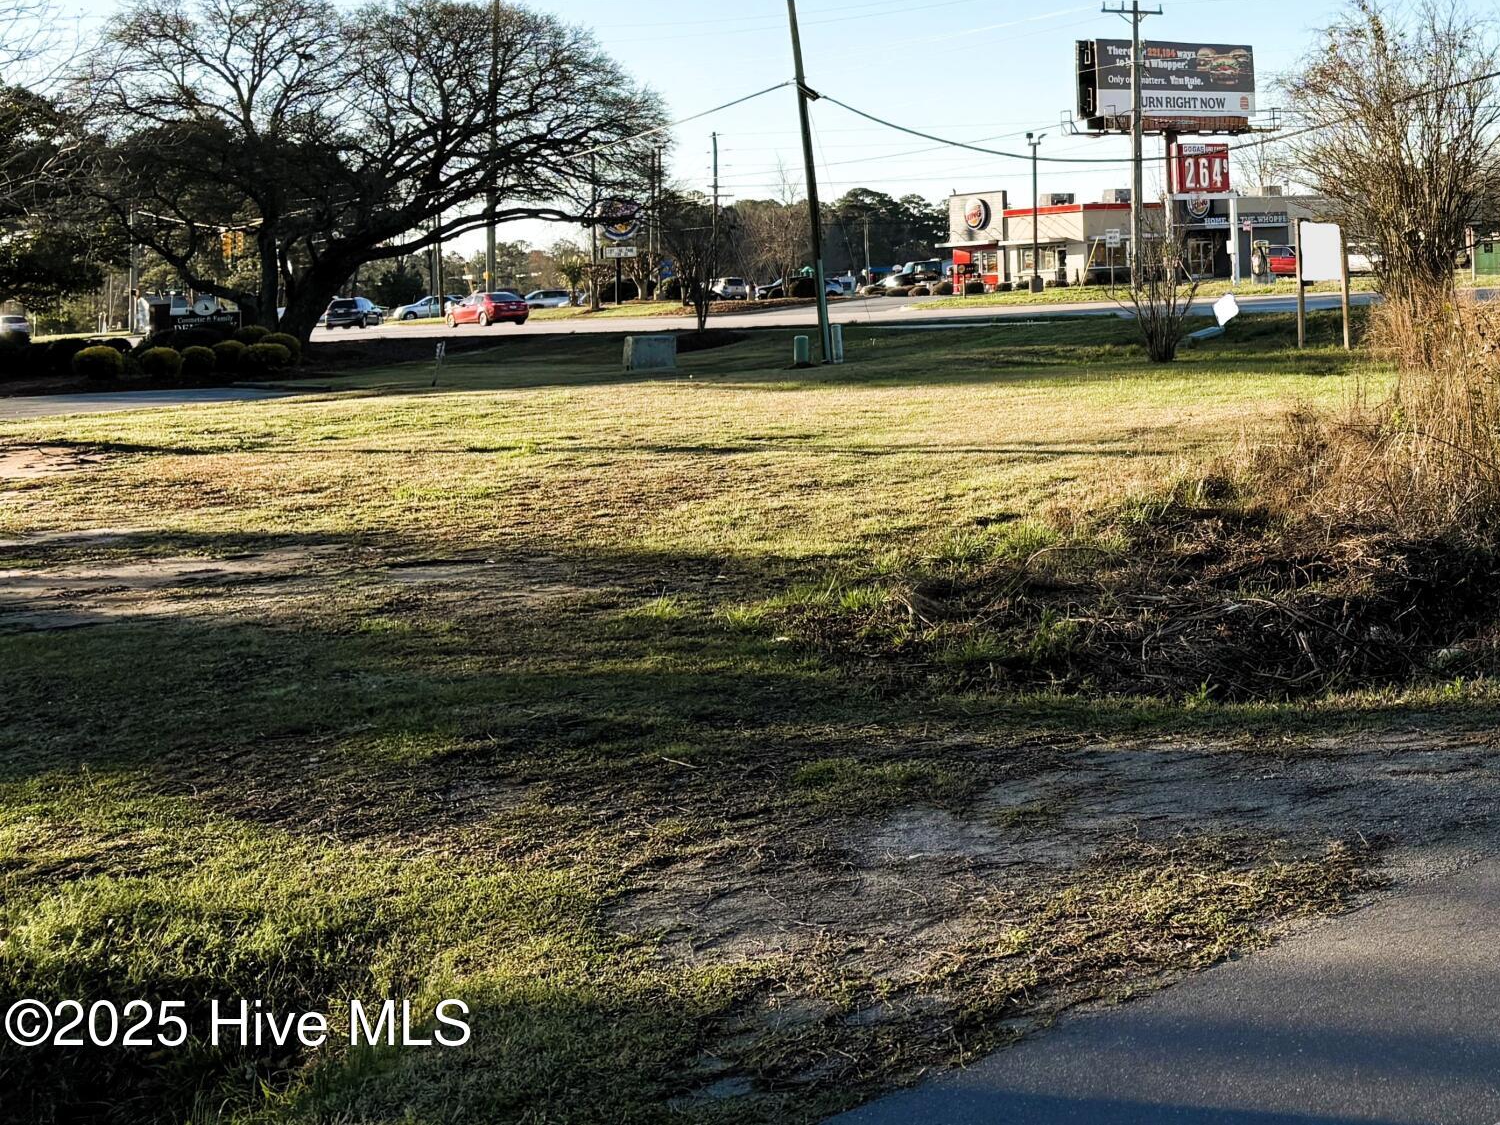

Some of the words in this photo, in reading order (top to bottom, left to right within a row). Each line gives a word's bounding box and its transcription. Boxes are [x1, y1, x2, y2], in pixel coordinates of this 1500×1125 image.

[1176, 50, 1196, 60] ways
[1108, 75, 1125, 85] Only
[1170, 75, 1184, 85] You
[1184, 76, 1204, 89] Rule.
[1141, 96, 1163, 108] URN
[1165, 96, 1198, 109] RIGHT
[1200, 97, 1226, 110] NOW
[1204, 216, 1226, 225] HOME
[213, 314, 233, 324] Family
